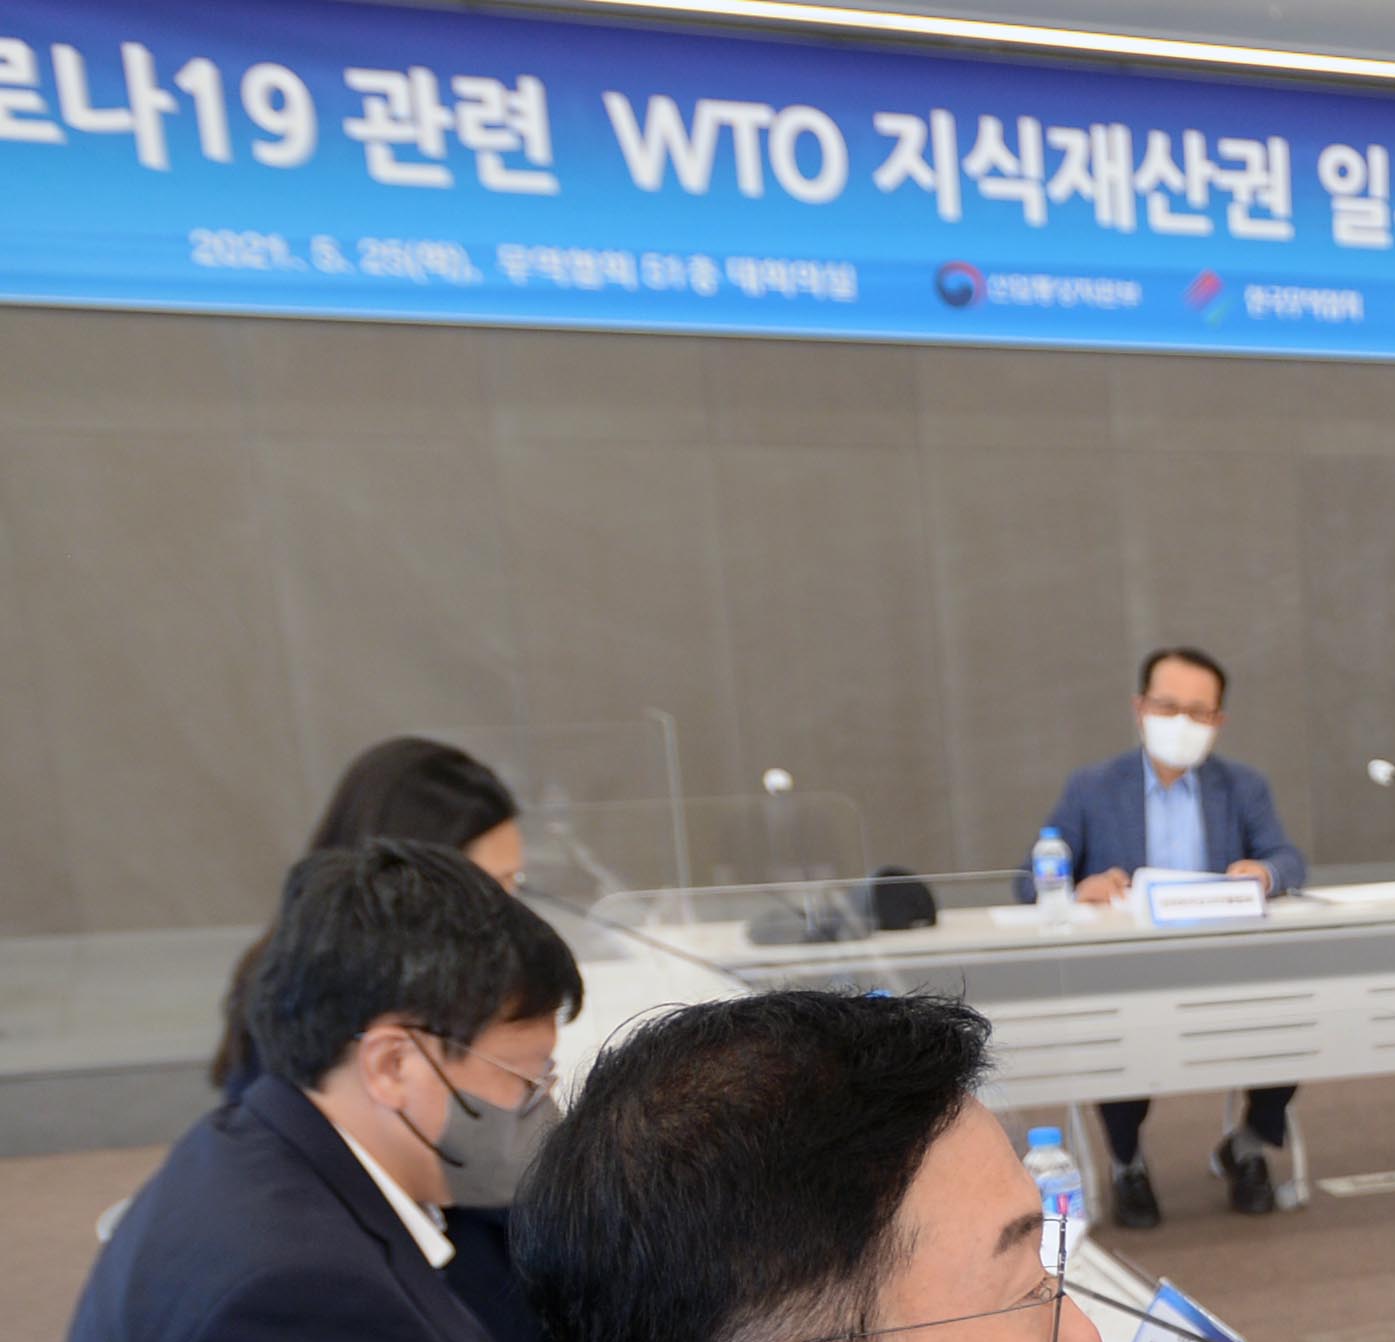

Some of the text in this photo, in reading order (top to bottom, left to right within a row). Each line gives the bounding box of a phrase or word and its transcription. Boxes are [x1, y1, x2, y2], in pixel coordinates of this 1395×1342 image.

[343, 65, 560, 194] 관련
[602, 90, 848, 204] WTO
[872, 108, 1295, 241] 지식재산권
